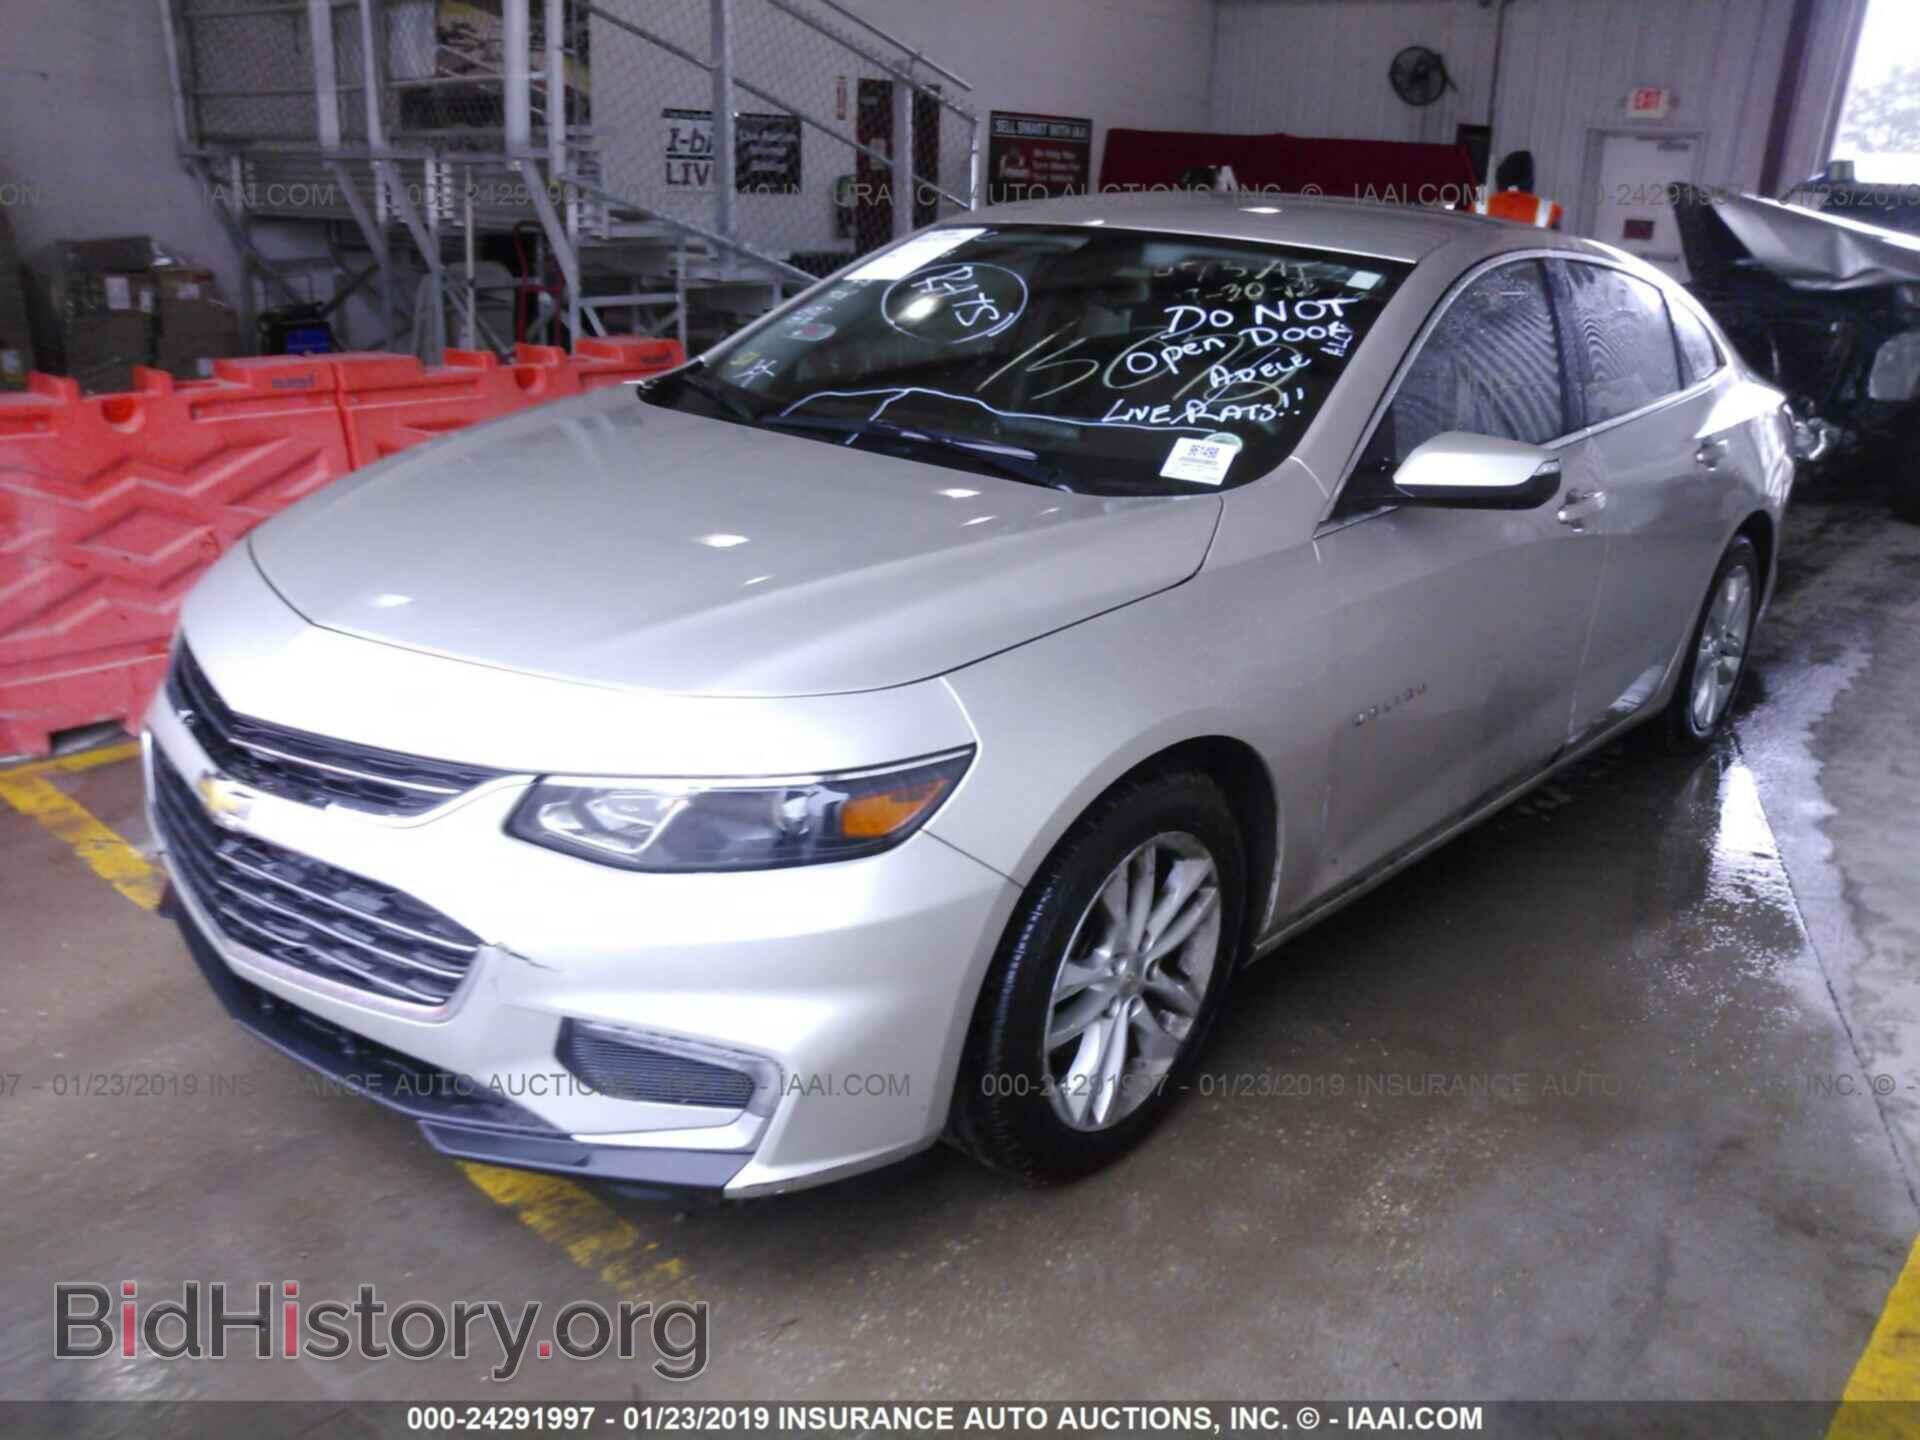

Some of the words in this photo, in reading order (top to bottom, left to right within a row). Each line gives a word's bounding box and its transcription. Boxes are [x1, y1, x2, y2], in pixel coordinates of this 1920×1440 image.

[1160, 305, 1234, 340] DO
[1254, 298, 1360, 324] NOT
[1101, 398, 1171, 424] LIVE
